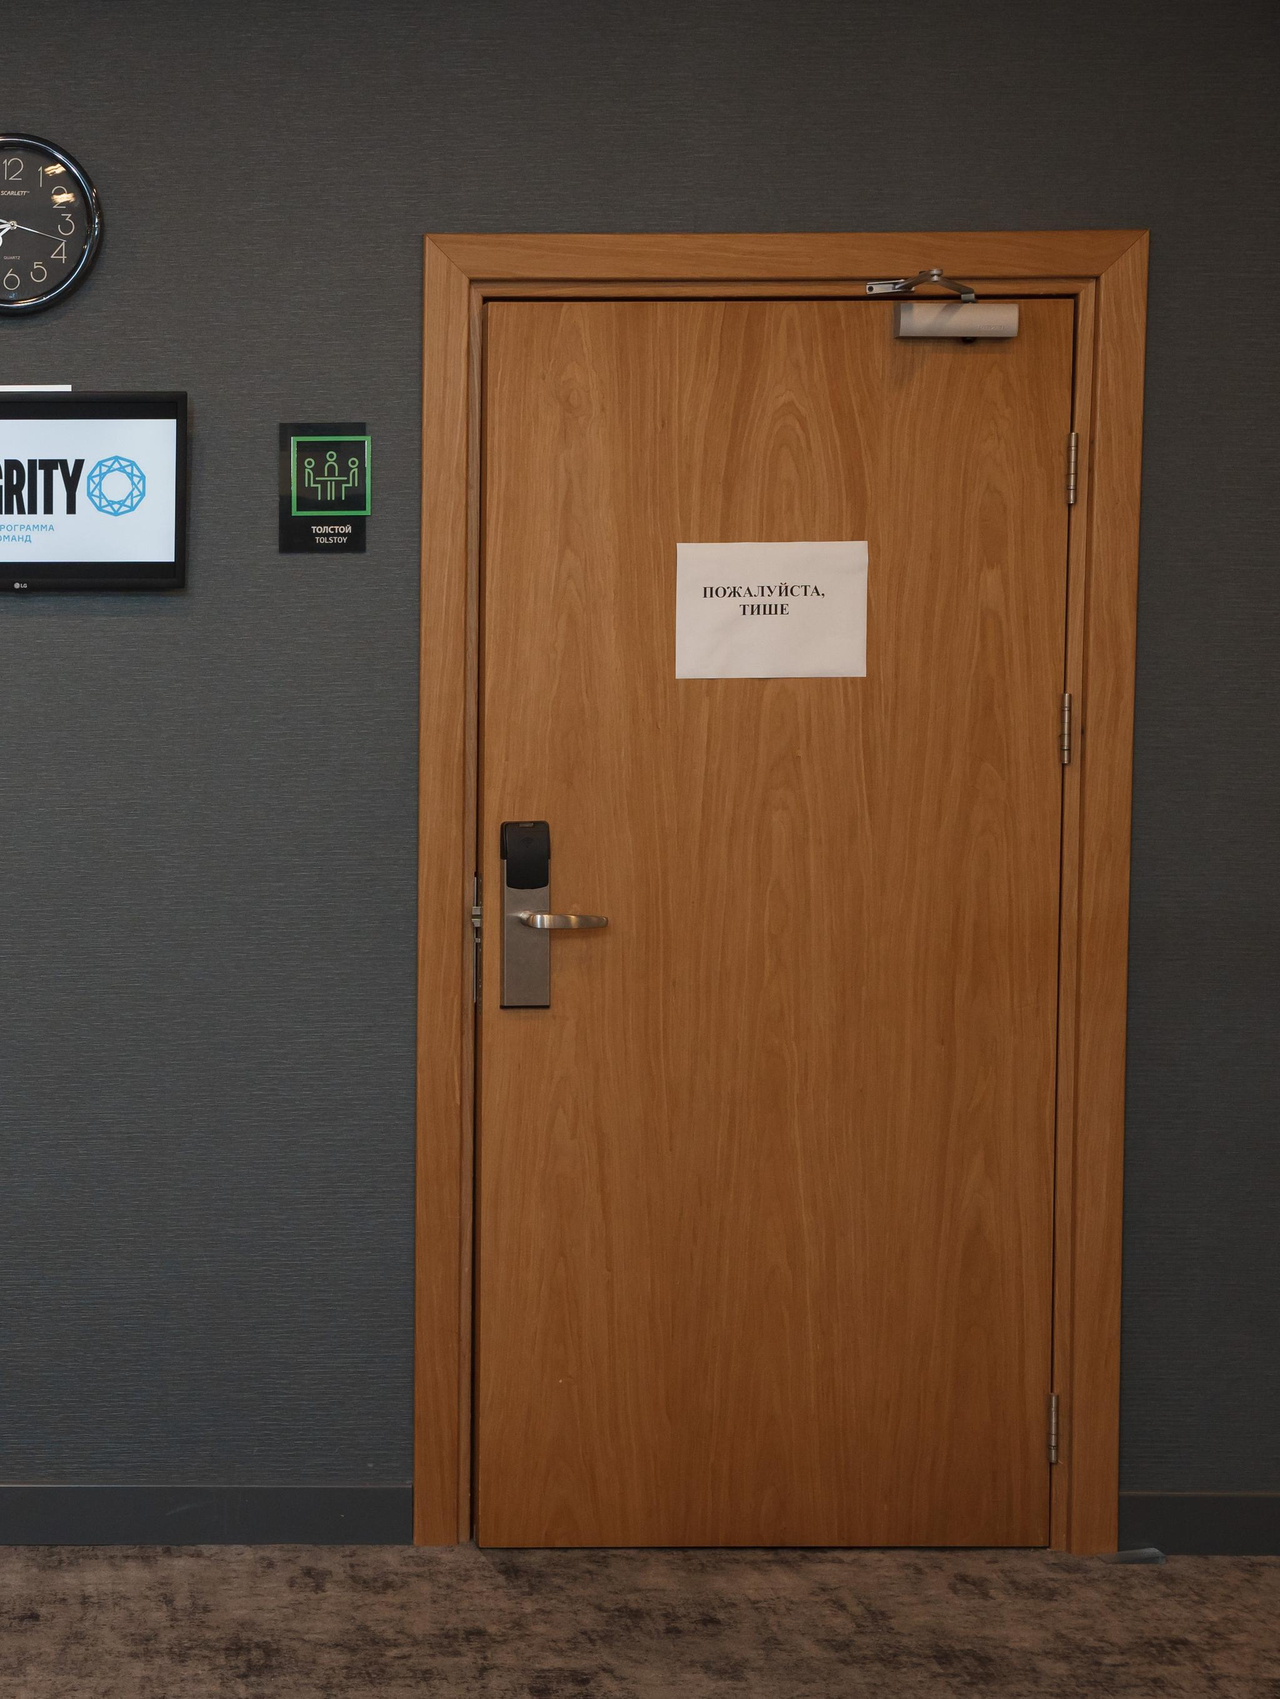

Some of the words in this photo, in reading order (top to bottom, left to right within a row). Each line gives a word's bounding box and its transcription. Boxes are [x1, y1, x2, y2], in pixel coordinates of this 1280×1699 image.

[2, 157, 24, 181] 12
[37, 165, 43, 188] 1
[57, 213, 75, 236] 3
[50, 241, 67, 264] 4
[3, 268, 20, 291] 6
[30, 261, 48, 283] 5
[311, 524, 352, 534] ТОЛСТОЙ
[315, 536, 348, 544] TOLSTOY
[702, 582, 826, 599] ПОЖАЛУЙСТА,
[739, 603, 790, 616] ТИШЕ
